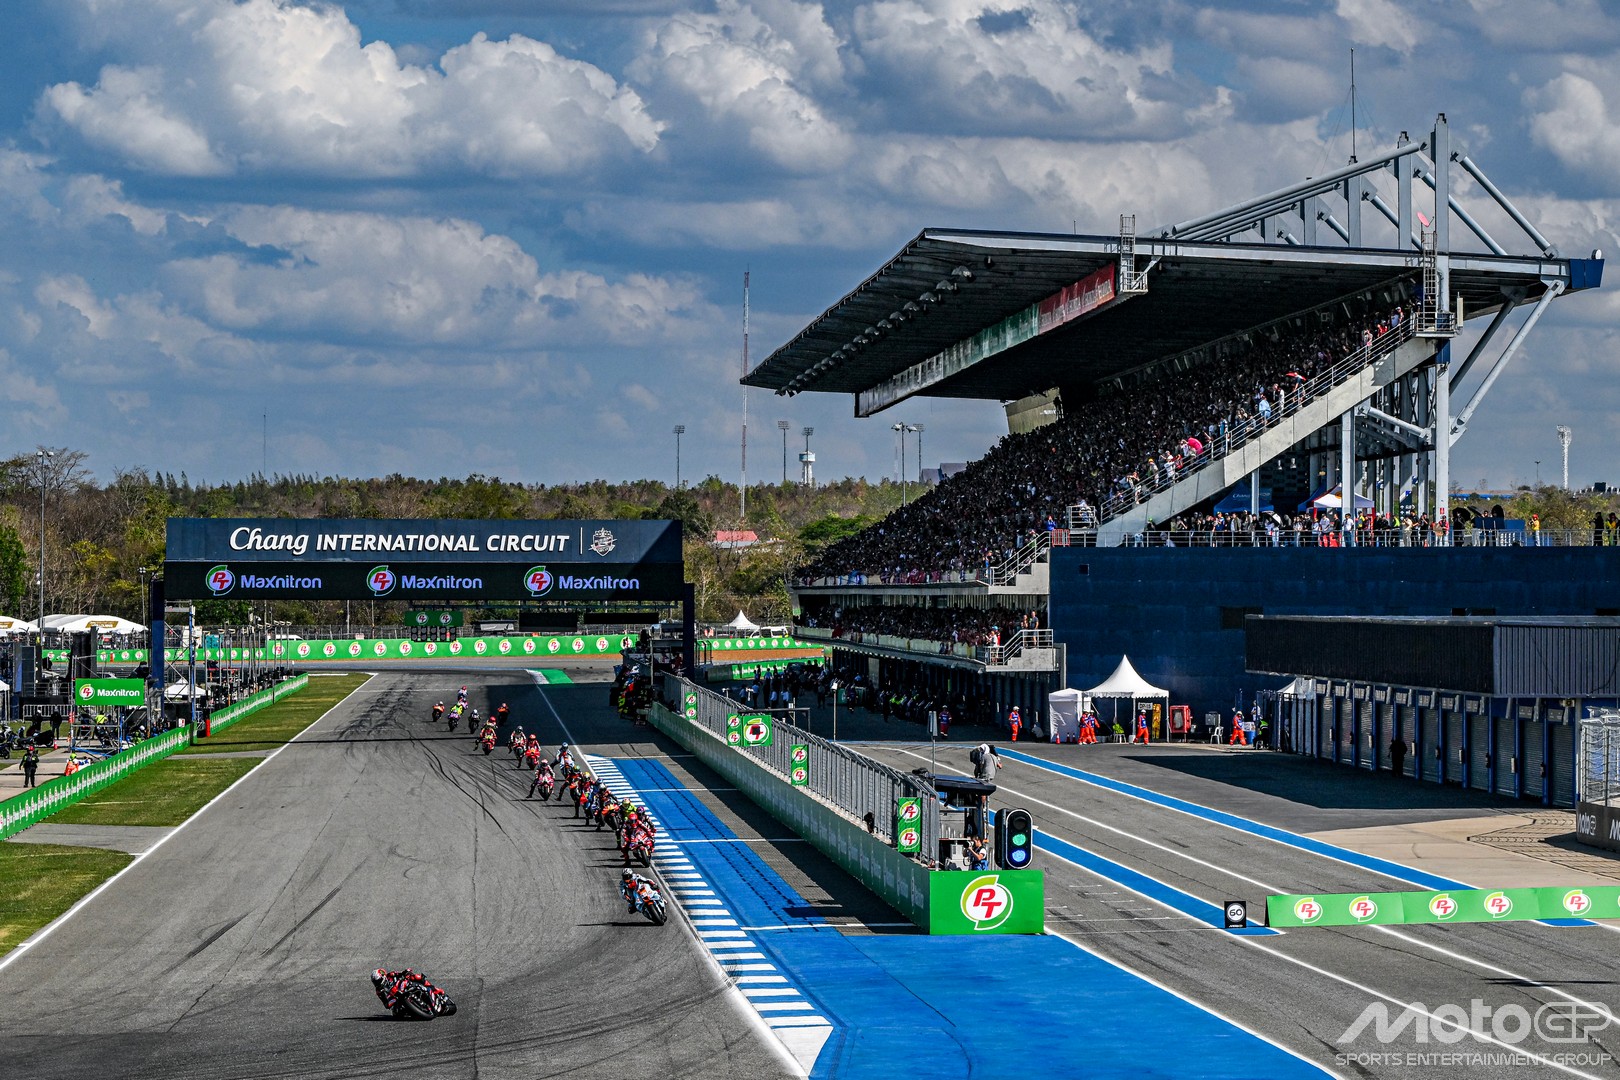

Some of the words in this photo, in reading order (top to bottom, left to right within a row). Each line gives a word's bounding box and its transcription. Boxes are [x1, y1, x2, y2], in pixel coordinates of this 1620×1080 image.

[229, 526, 309, 555] Chang
[316, 534, 479, 551] INTERNATIONAL
[486, 534, 570, 551] CIRCUIT
[212, 571, 229, 590] PT
[240, 575, 322, 589] Maxnitron
[373, 572, 390, 590] PT
[401, 575, 483, 589] Maxnitron
[531, 572, 547, 590] PT
[558, 575, 640, 590] Maxnitron
[97, 689, 140, 697] Maxnitron
[972, 888, 1002, 919] PT
[1300, 903, 1317, 918] PT
[1356, 901, 1371, 917] PT
[1435, 899, 1452, 914] PT
[1491, 897, 1507, 913] PT
[1569, 895, 1585, 910] PT
[1229, 908, 1243, 917] 60
